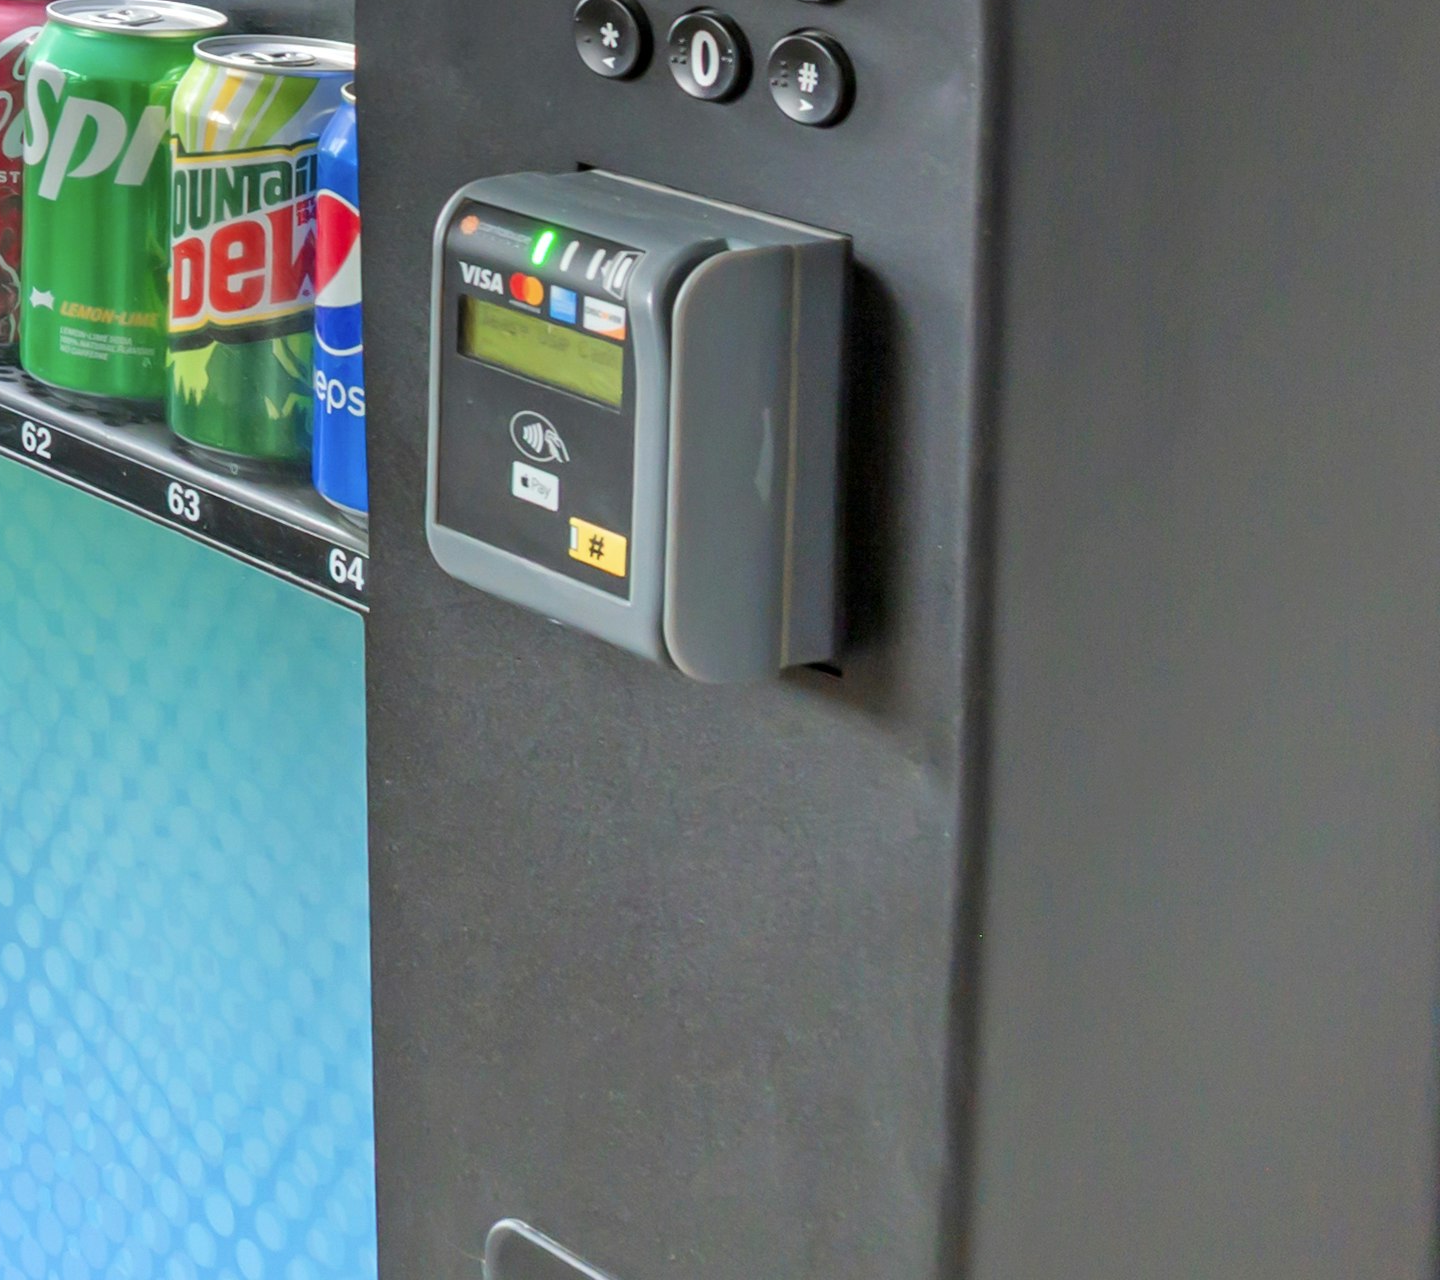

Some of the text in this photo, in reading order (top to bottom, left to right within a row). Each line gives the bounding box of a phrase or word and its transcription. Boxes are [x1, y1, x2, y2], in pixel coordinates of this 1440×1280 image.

[690, 30, 719, 86] 0
[459, 262, 503, 296] VISA
[61, 301, 159, 329] LEMON-LIME
[22, 422, 52, 459] 62
[168, 484, 201, 522] 63
[531, 476, 552, 499] Pay
[329, 549, 365, 591] 64
